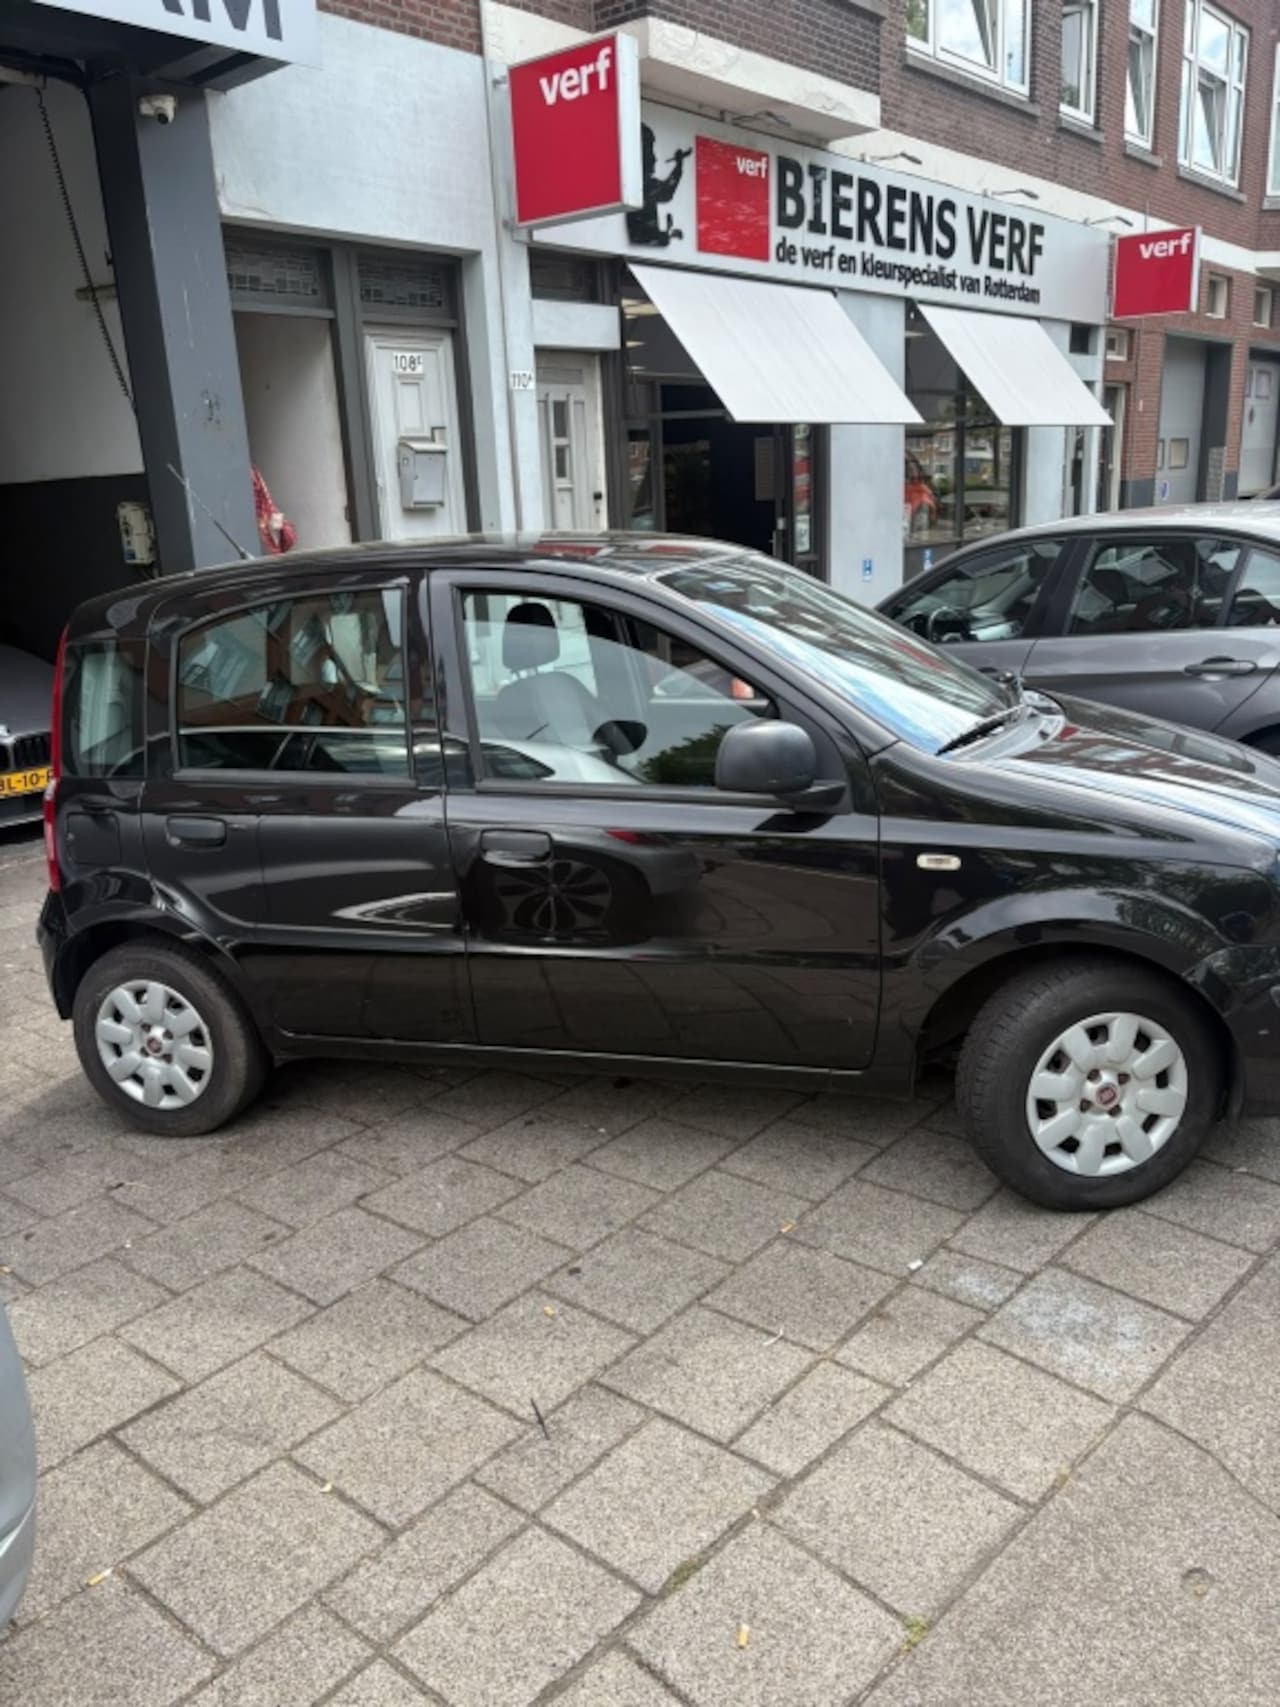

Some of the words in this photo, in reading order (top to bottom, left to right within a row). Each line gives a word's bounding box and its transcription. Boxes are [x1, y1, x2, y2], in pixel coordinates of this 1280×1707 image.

[539, 45, 612, 106] verf
[736, 157, 768, 179] verf
[777, 155, 957, 260] BIERENS
[966, 205, 1045, 276] VERF
[1139, 232, 1192, 259] verf
[776, 236, 797, 265] de
[801, 245, 836, 271] verf
[838, 253, 857, 275] en
[861, 251, 958, 291] kleurspecialist
[960, 275, 981, 294] van
[984, 275, 1041, 304] Rotterdam
